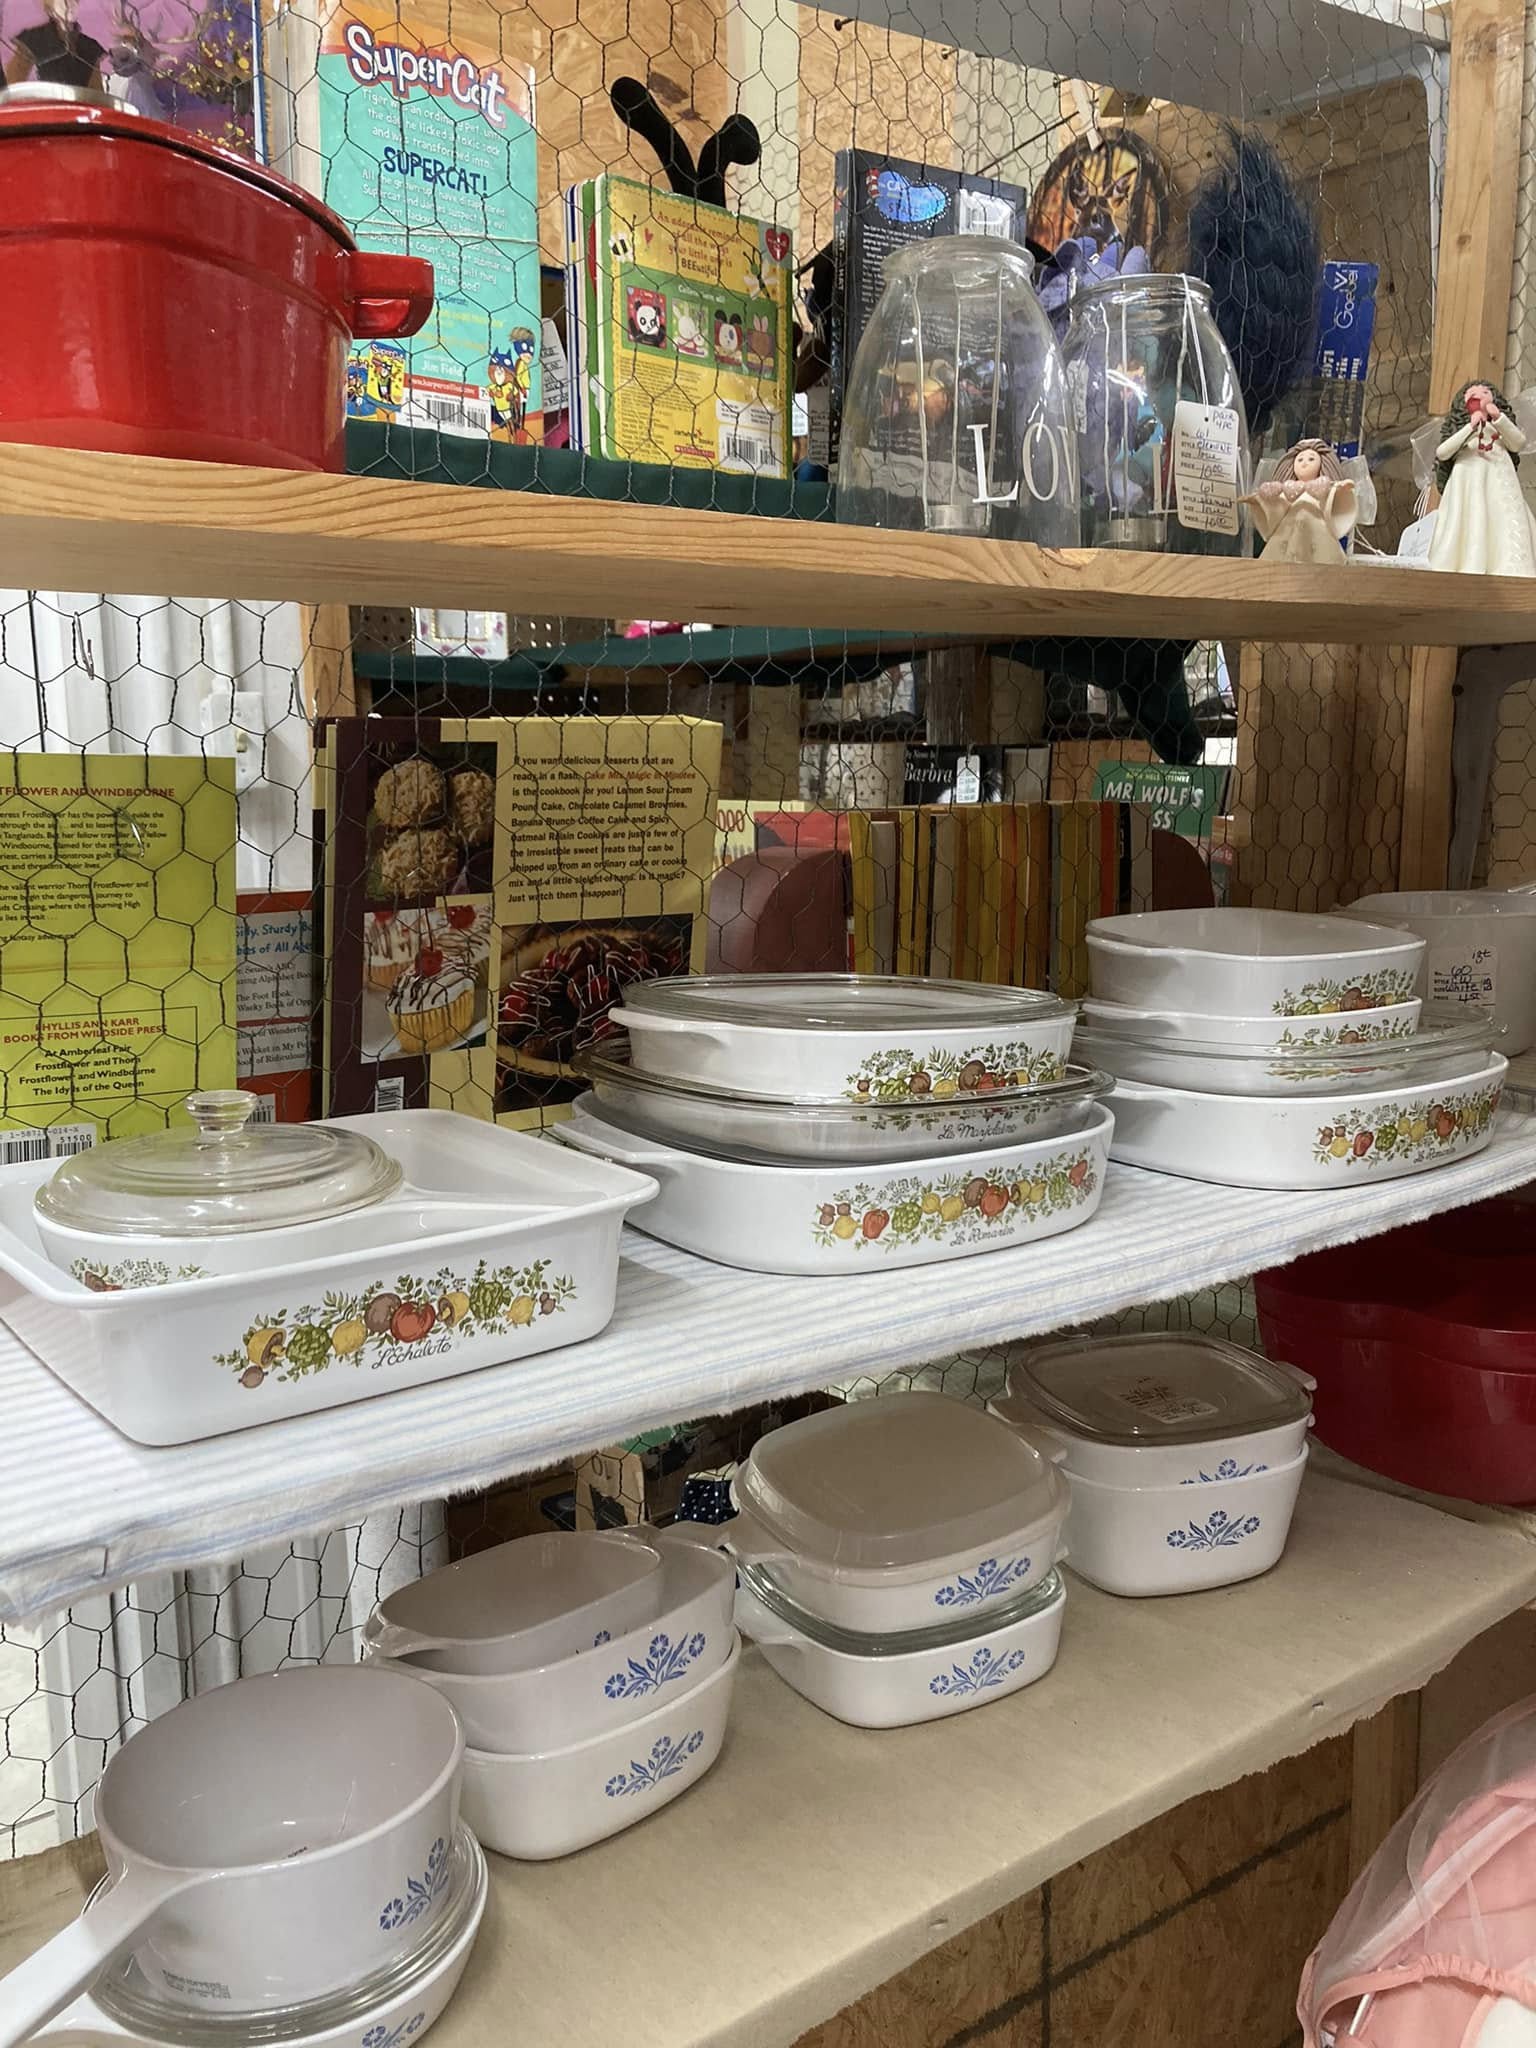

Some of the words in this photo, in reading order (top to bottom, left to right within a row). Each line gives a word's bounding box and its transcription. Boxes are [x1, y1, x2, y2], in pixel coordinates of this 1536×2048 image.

[347, 25, 505, 123] SuperCat
[384, 146, 488, 199] SUPERCAT!
[1336, 270, 1358, 328] Goebel
[564, 756, 600, 765] delicious
[513, 773, 536, 781] ready
[539, 772, 547, 780] in
[904, 763, 953, 783] Barbra
[513, 788, 520, 796] is
[523, 788, 538, 796] the
[539, 787, 580, 796] cookbook
[597, 787, 614, 797] you!
[646, 786, 664, 794] Sour
[1105, 781, 1135, 800] MR.
[512, 818, 543, 827] Banana
[654, 829, 667, 837] few
[670, 829, 678, 837] of
[573, 846, 598, 855] sweet
[647, 844, 661, 852] can
[664, 843, 673, 852] be
[22, 852, 46, 860] carries
[509, 863, 545, 873] whipped
[547, 863, 557, 872] up
[509, 879, 523, 888] mix
[553, 876, 572, 884] little
[657, 870, 685, 881] magic?
[38, 883, 65, 891] warrior
[42, 893, 54, 901] the
[508, 893, 525, 902] Just
[557, 890, 577, 899] them
[48, 902, 72, 910] where
[124, 901, 140, 909] High
[262, 922, 297, 935] Sturdy
[259, 943, 270, 954] of
[275, 942, 289, 952] All
[111, 1018, 139, 1027] KARR
[47, 1031, 79, 1041] FROM
[81, 1028, 135, 1039] WILDSIDE
[137, 1025, 167, 1035] PRESS
[59, 1045, 110, 1056] Amberleaf
[93, 1058, 111, 1067] and
[78, 1071, 95, 1080] and
[32, 1087, 53, 1096] The
[55, 1084, 80, 1096] Idyls
[83, 1083, 92, 1092] of
[95, 1082, 110, 1091] the
